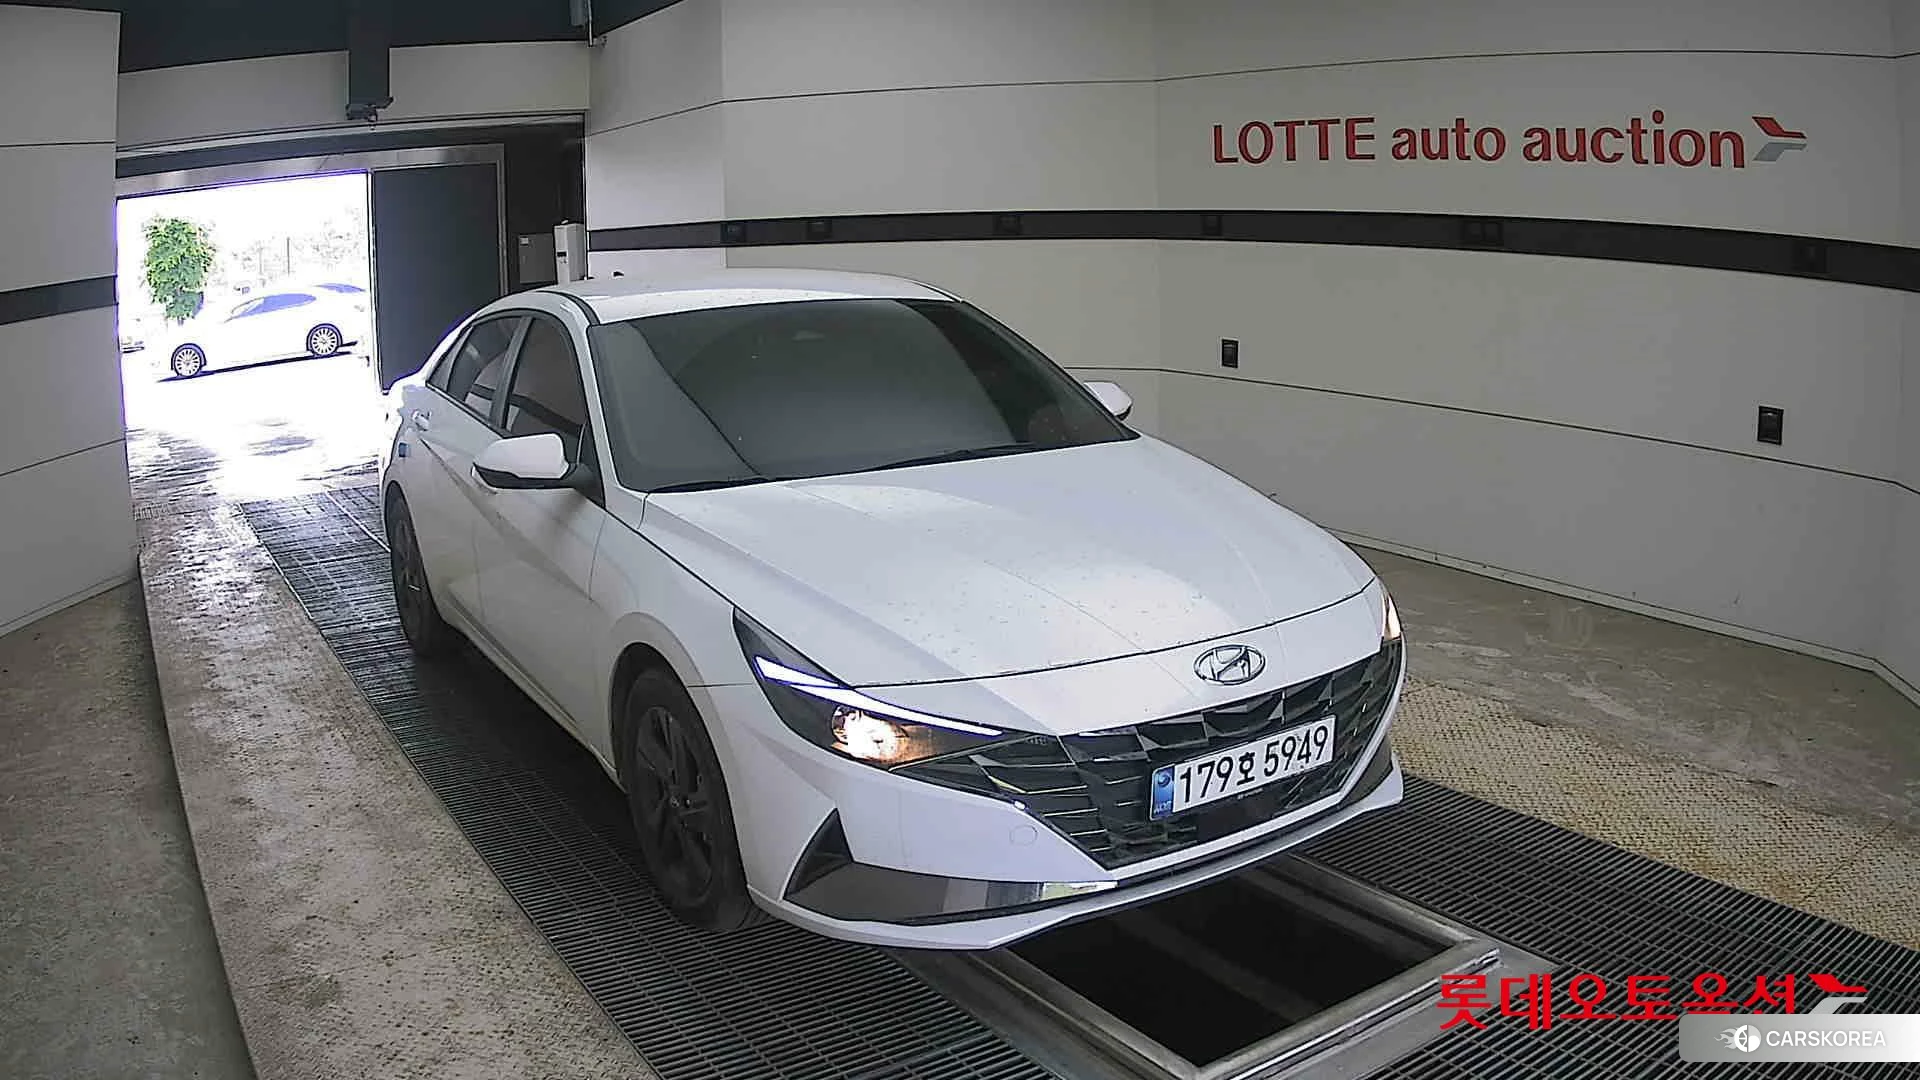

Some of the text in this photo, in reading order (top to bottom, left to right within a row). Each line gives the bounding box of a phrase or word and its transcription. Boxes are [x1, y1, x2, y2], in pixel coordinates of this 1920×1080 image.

[1212, 109, 1747, 169] LOTTE auto auction
[1179, 724, 1330, 803] 179호 5949
